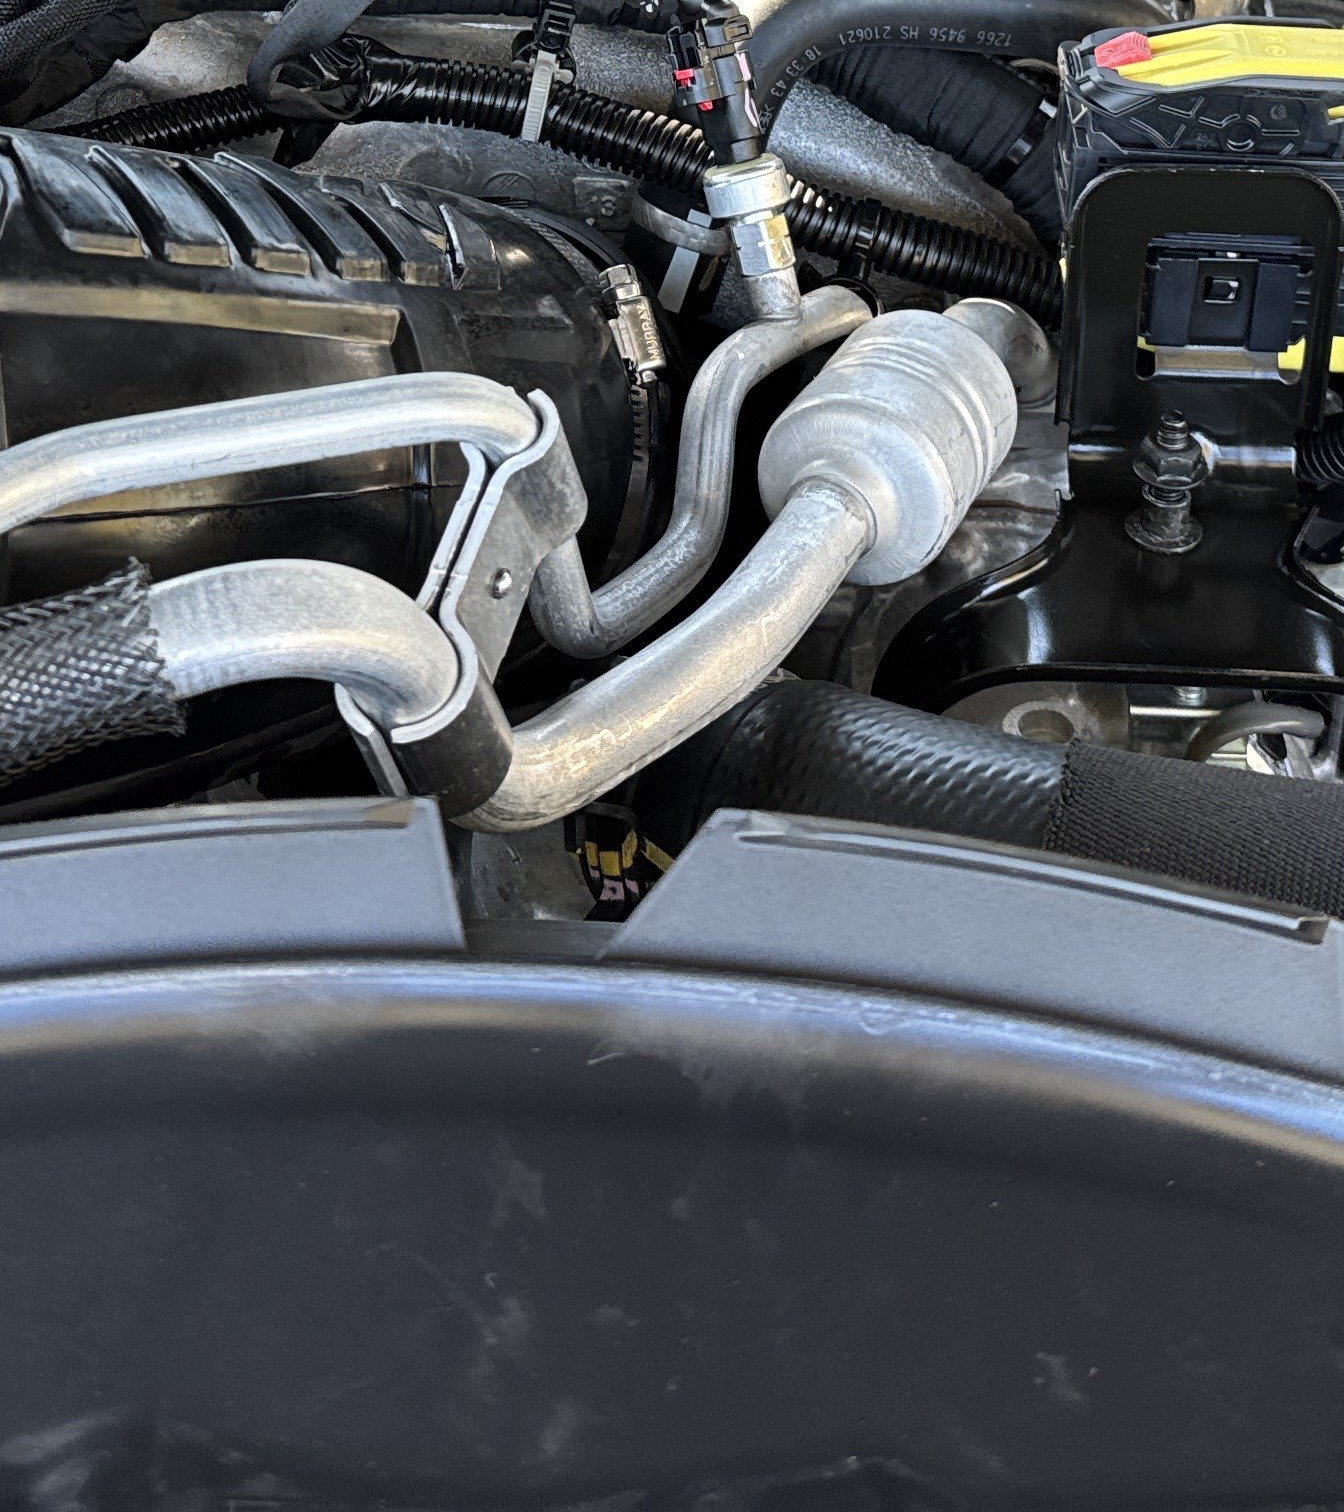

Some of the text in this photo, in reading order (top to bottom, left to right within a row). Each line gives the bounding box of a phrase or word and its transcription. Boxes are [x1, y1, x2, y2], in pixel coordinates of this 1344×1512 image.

[838, 25, 891, 46] 210621
[899, 25, 919, 40] HS
[929, 27, 966, 43] 9456
[637, 304, 661, 361] MURRAY
